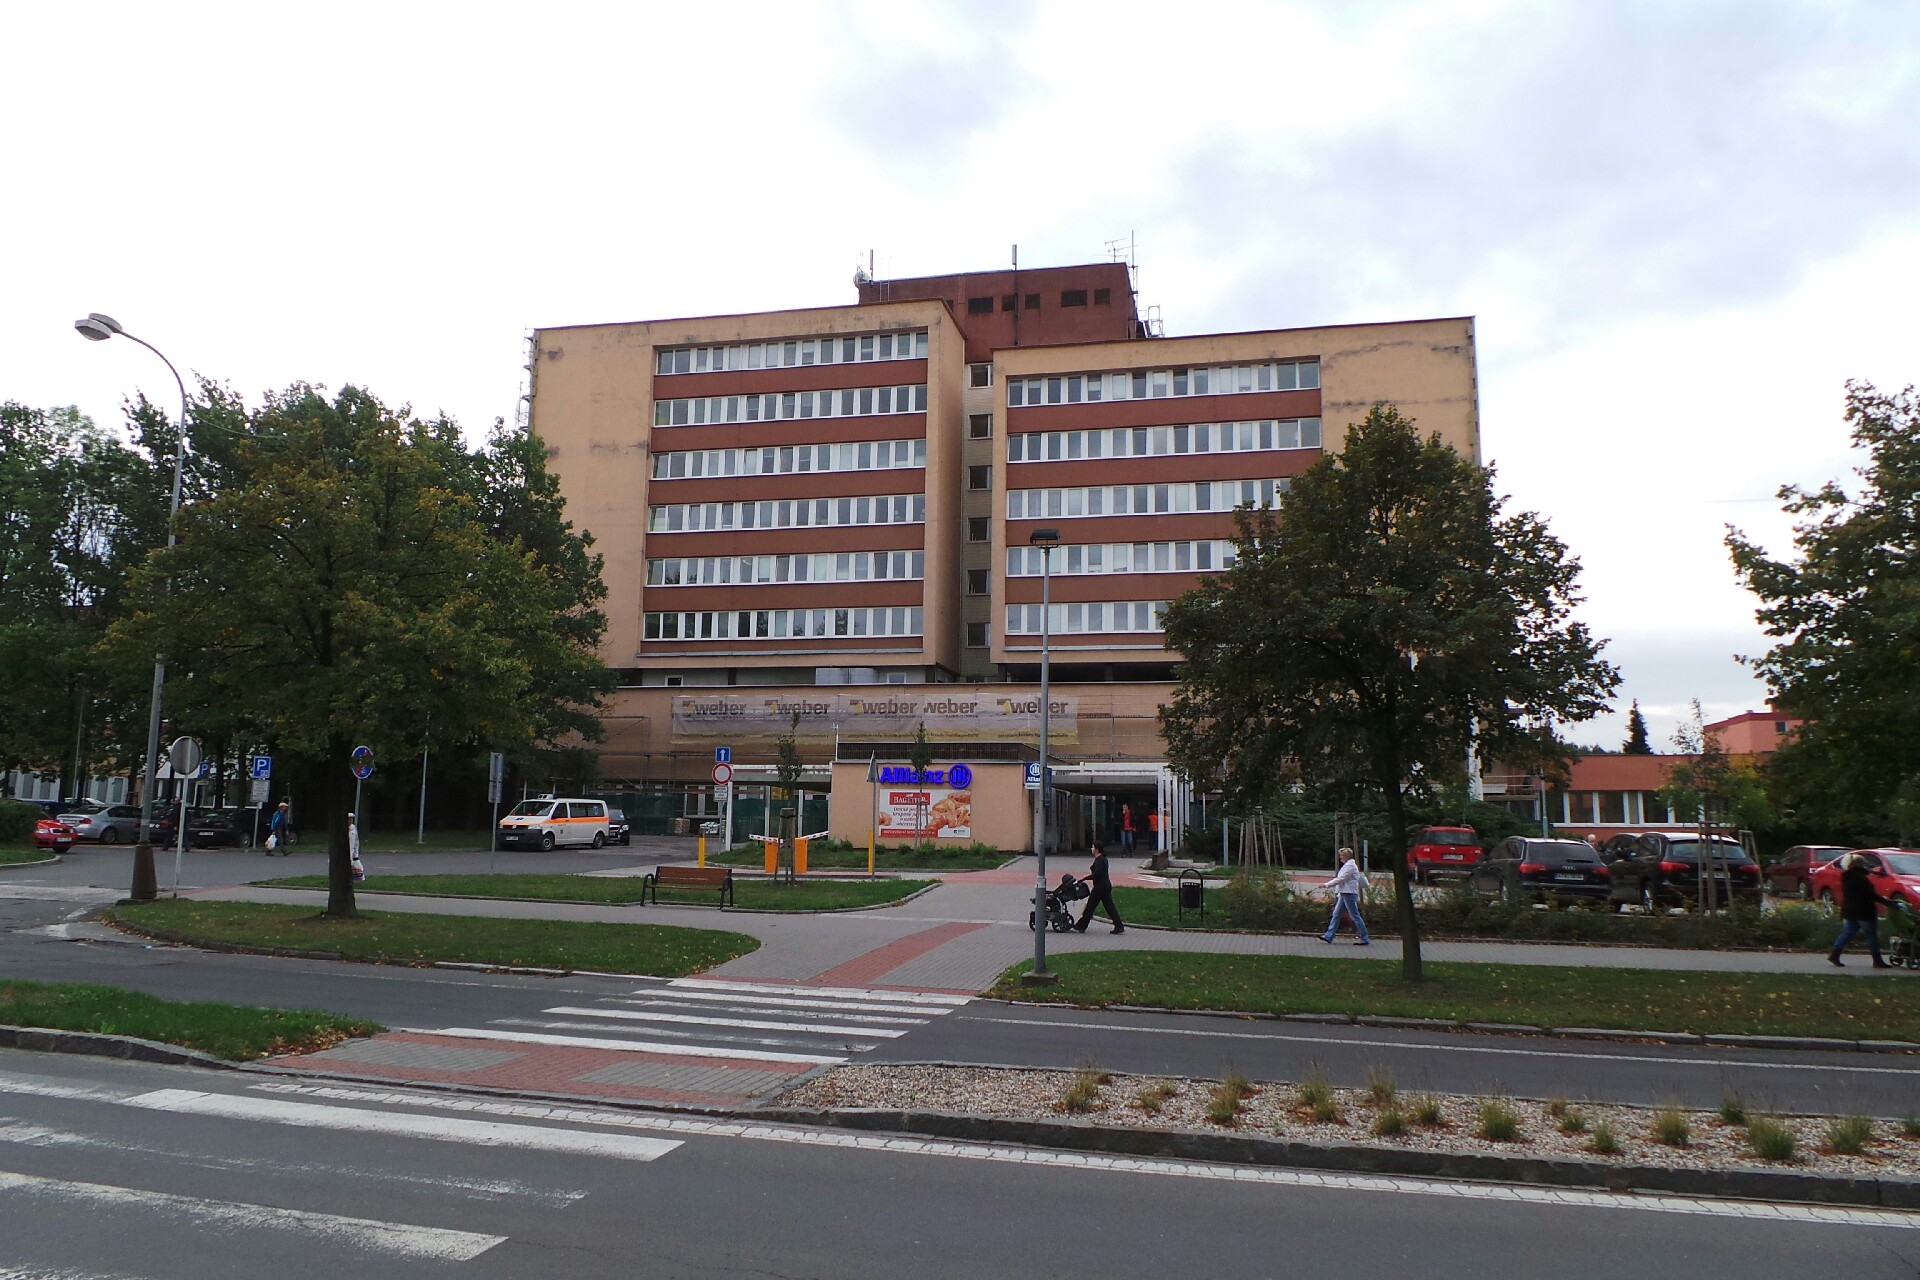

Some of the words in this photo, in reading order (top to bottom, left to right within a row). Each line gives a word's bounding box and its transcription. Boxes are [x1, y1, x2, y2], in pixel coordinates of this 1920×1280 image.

[695, 700, 747, 715] weber
[777, 700, 830, 715] weber
[862, 699, 917, 714] weber
[924, 698, 977, 714] weber
[1010, 698, 1068, 713] weer
[201, 763, 209, 774] P
[257, 759, 267, 771] P
